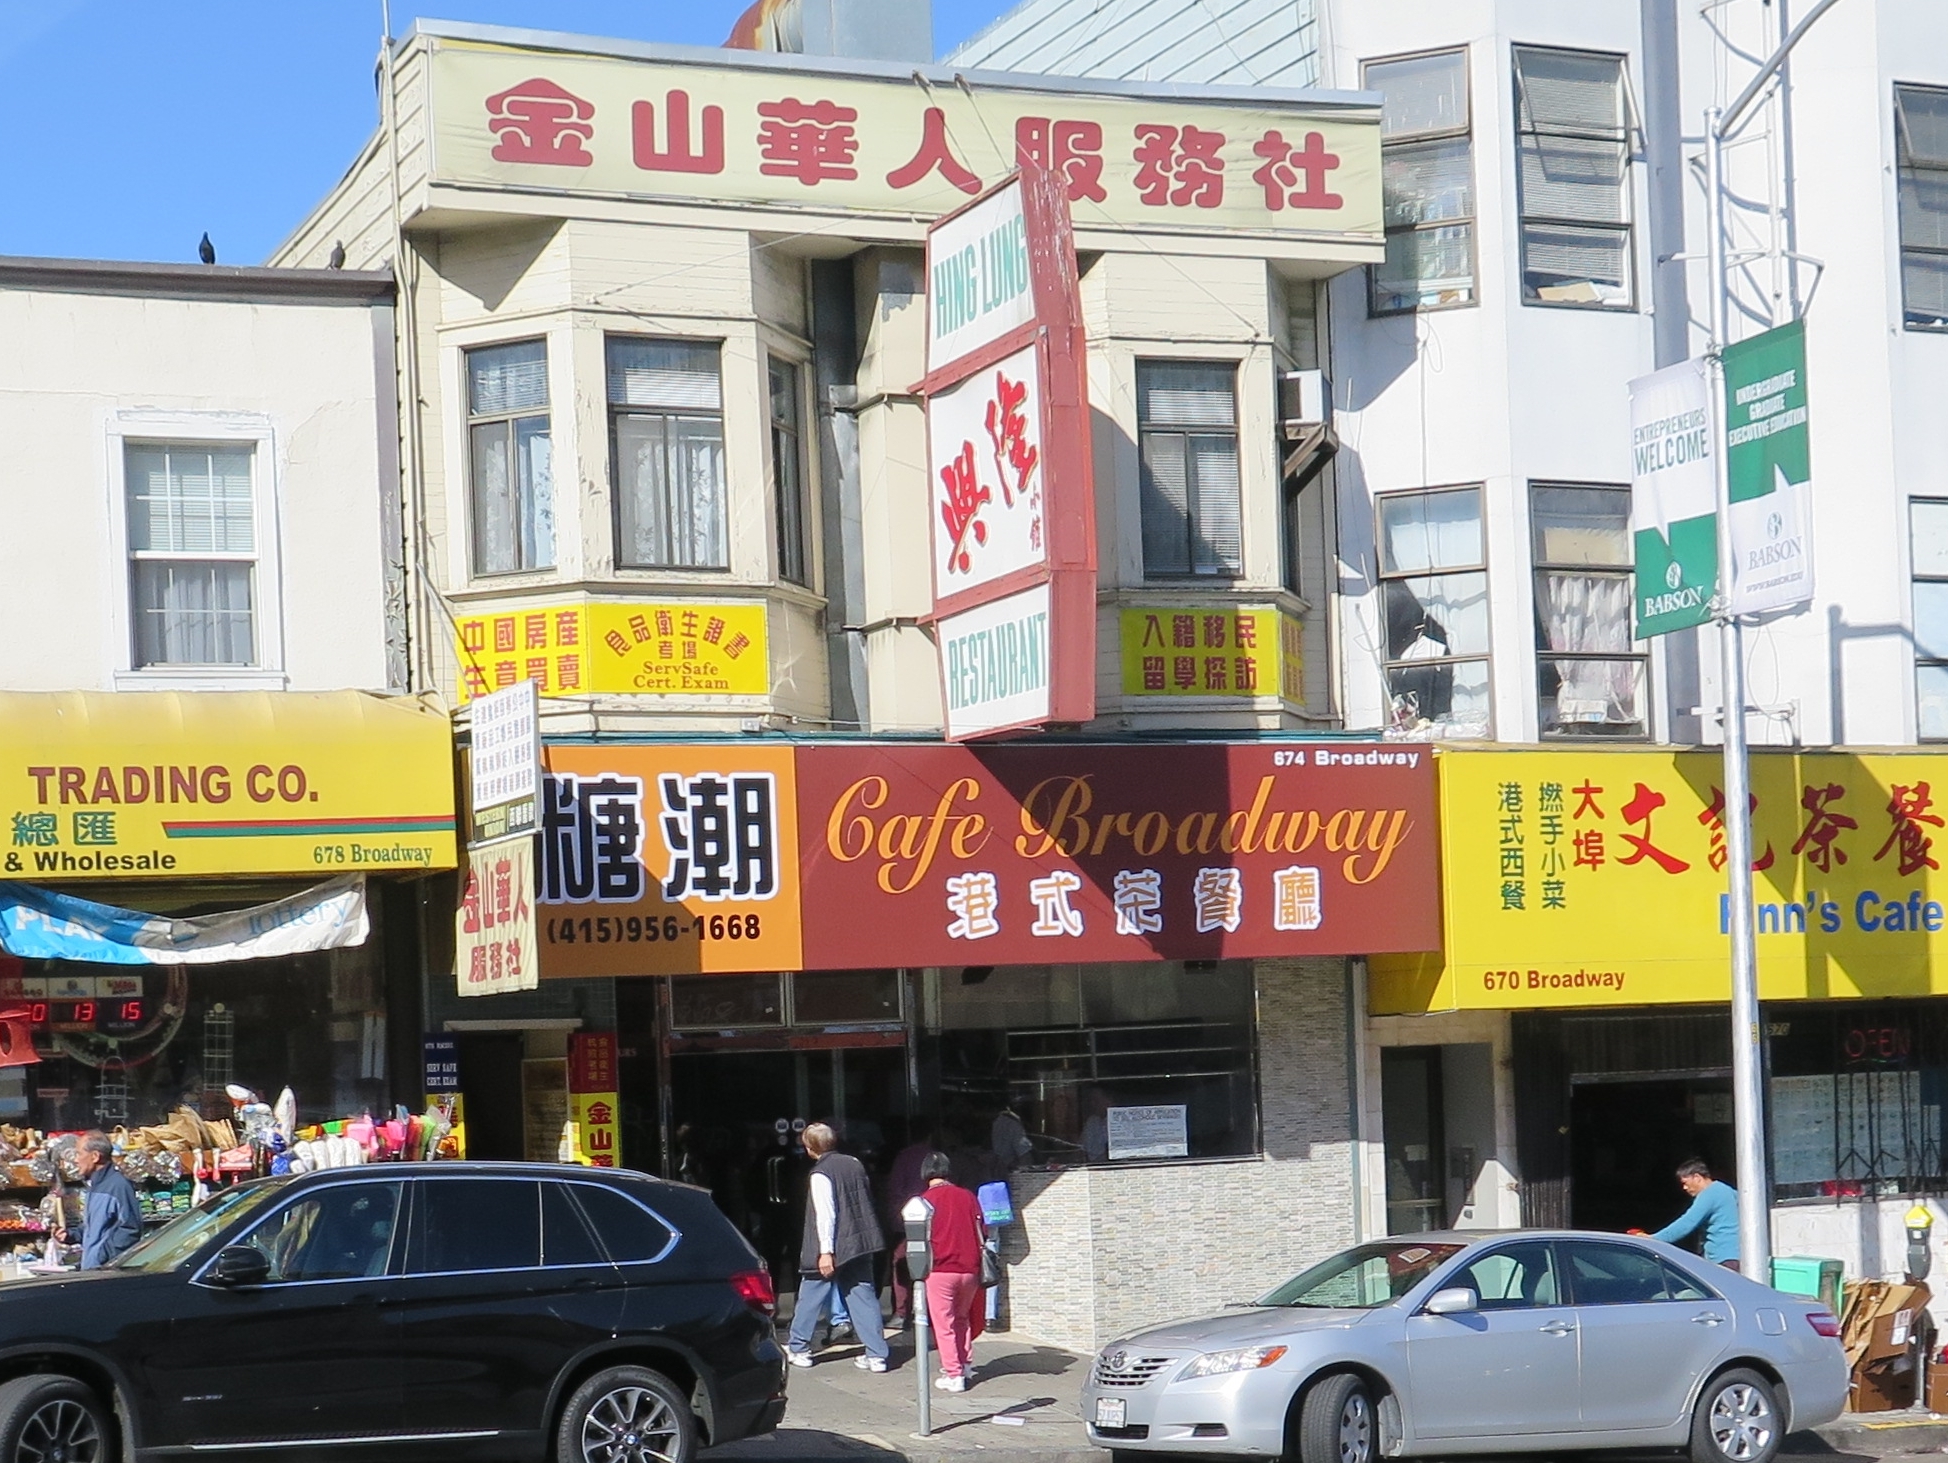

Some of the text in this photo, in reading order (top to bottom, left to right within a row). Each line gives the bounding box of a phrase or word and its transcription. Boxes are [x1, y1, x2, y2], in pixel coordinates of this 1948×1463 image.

[485, 78, 1343, 210] 金山華人服務社
[934, 214, 1028, 338] HING LUNG
[1634, 407, 1706, 445] ENTREPRENEURS
[1635, 427, 1710, 476] WELCOME
[1749, 536, 1802, 571] BABSON
[1644, 585, 1704, 617] BABSON
[1142, 614, 1257, 648] 入籍移民
[658, 640, 697, 660] 考場
[948, 612, 1047, 711] RESTAURANT
[633, 675, 730, 689] Cert. Exam
[643, 661, 719, 676] ServSafe
[1274, 750, 1420, 769] 674 Broadway
[28, 764, 319, 805] TRADING CO.
[826, 774, 1415, 894] Cafe Broadway
[1572, 778, 1605, 872] 大埠
[4, 850, 177, 872] & Wholesale
[313, 842, 433, 867] 678 Broadway
[1498, 782, 1526, 911] 港式西餐
[947, 867, 1321, 939] 港式茶餐廳
[1720, 889, 1944, 933] nn's Cafe
[547, 913, 761, 945] (415)956-1668
[1484, 968, 1626, 992] 670 Broadway
[74, 1002, 94, 1021] 13
[121, 1002, 140, 1020] 15
